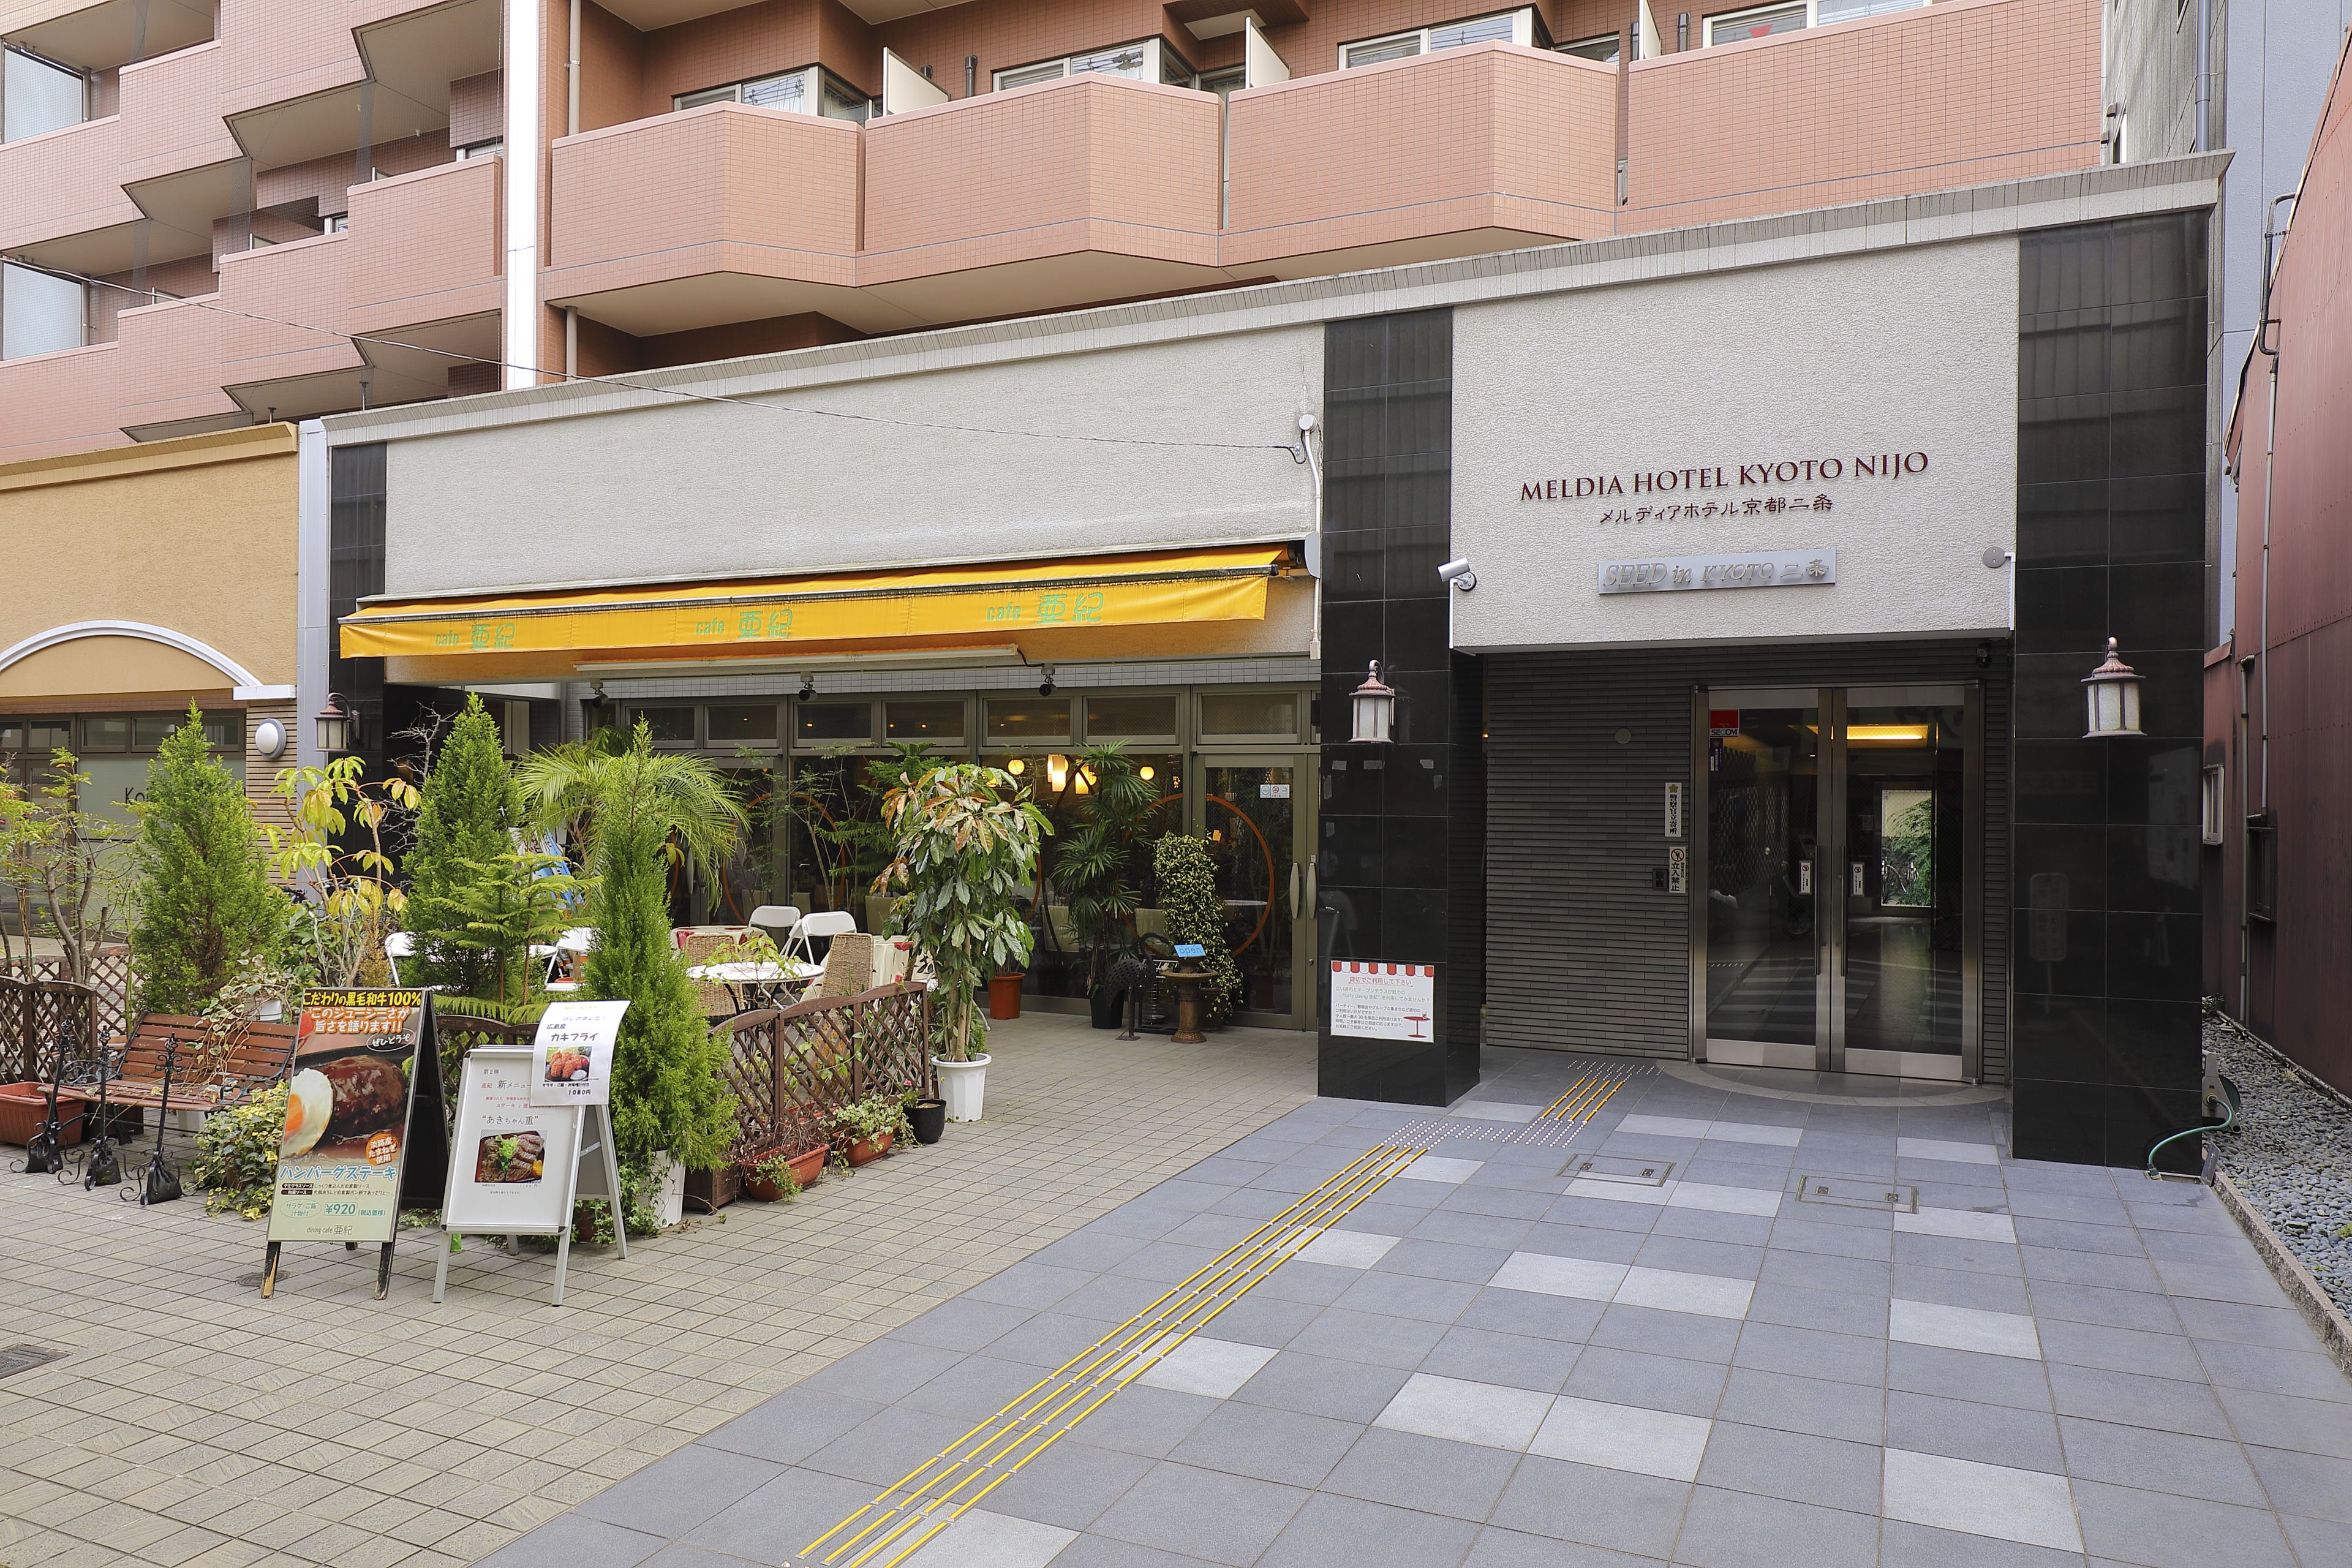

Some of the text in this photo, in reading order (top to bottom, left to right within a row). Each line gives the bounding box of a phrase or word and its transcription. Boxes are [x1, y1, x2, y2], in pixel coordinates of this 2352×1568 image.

[1521, 451, 1928, 500] MELDIA HOTEL KYOTO NIJO
[1599, 493, 1833, 524] メルディアホテル京都二条
[1602, 558, 1830, 586] SEED in KYOTO 二条
[987, 592, 1104, 625] cafe 亜紀
[696, 609, 793, 639] cafe 亜紀
[435, 622, 516, 649] cafe 亜紀
[1669, 794, 1678, 835] 警察官立寄所
[1671, 862, 1680, 892] 立入禁止
[1179, 947, 1202, 956] open
[1349, 976, 1412, 986] 貸切でご利用して下さい
[303, 991, 422, 1007] こだわりの黒毛和牛100%
[311, 1008, 410, 1019] このジューシーさが
[315, 1020, 402, 1032] 旨さを語ります!!
[372, 1033, 411, 1047] ぜひどうぞ
[551, 1033, 598, 1041] カキフライ
[370, 1136, 393, 1149] 淡路産
[368, 1144, 397, 1158] たまねぎ
[375, 1155, 392, 1164] 使用
[278, 1165, 398, 1180] ハンバーグステーキ
[325, 1204, 356, 1215] ¥920
[333, 1226, 353, 1235] 亜紀
